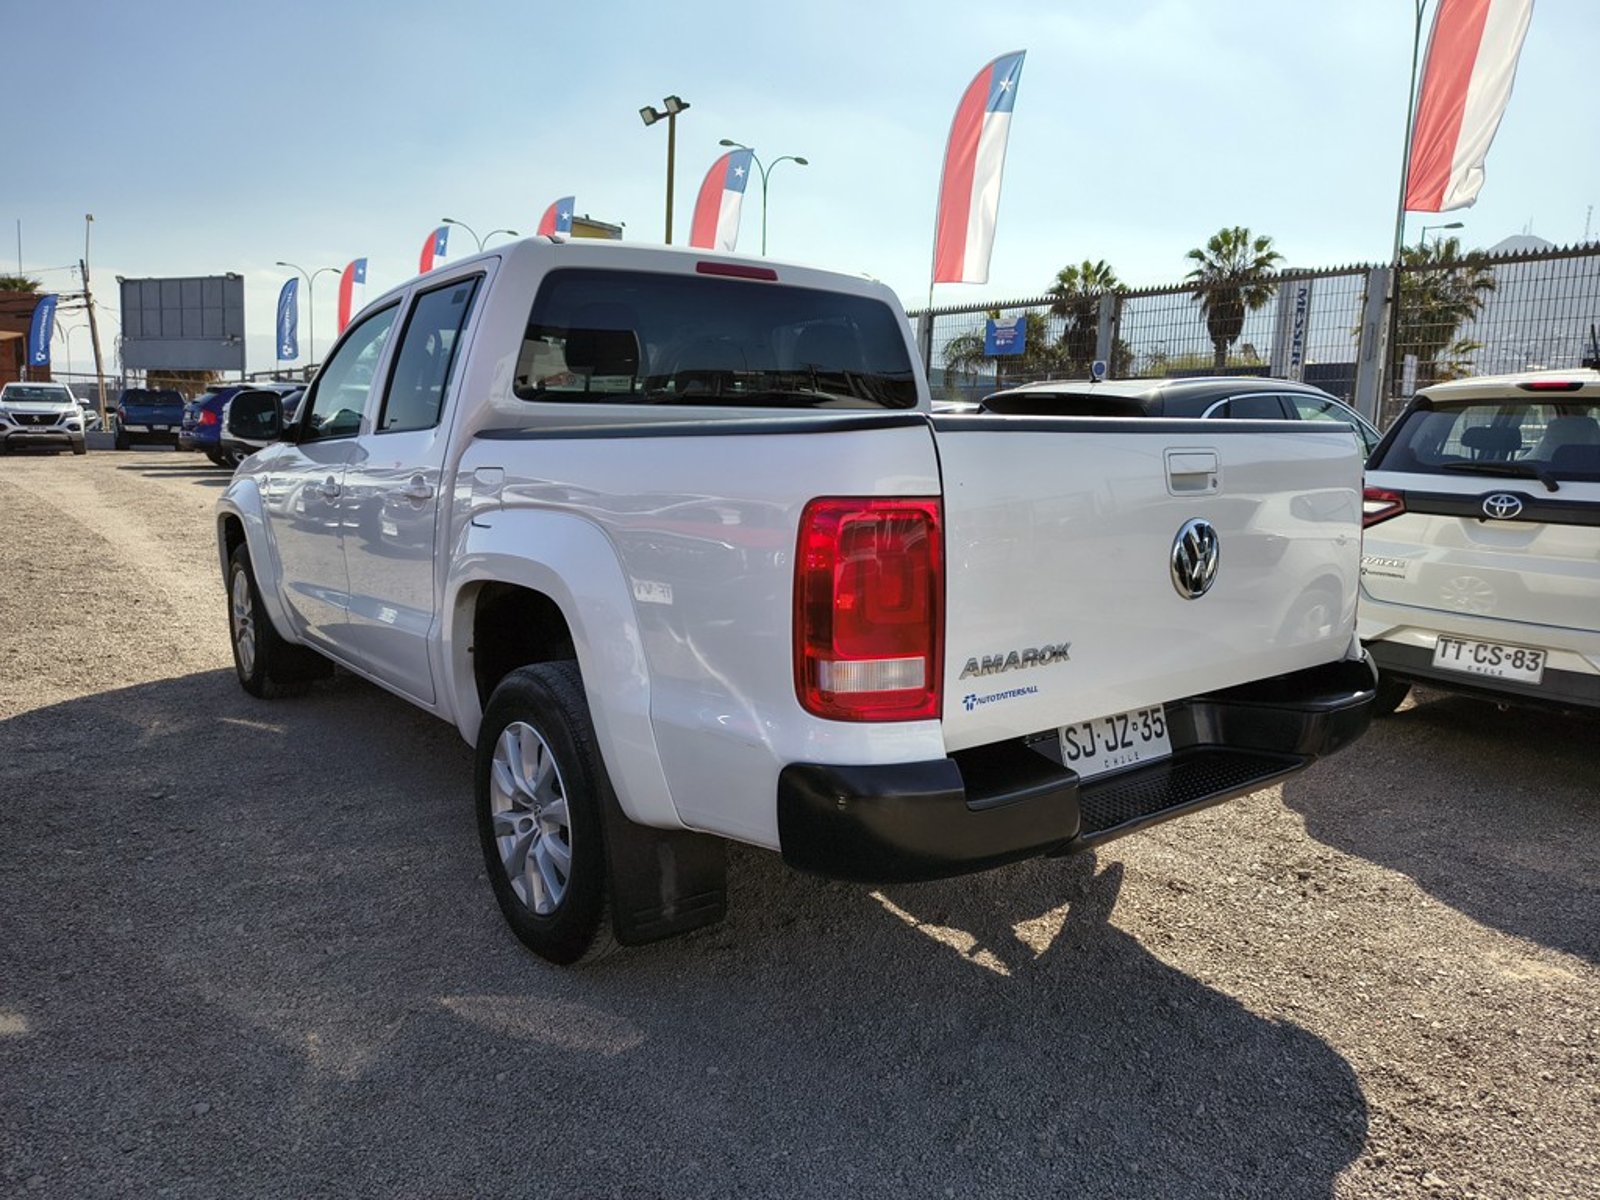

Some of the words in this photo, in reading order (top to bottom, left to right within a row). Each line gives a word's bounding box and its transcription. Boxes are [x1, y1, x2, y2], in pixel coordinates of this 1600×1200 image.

[1292, 288, 1307, 366] MESSER
[958, 641, 1072, 680] AMAROK
[976, 685, 1038, 705] AUTOTATTERSALL
[1104, 752, 1139, 768] CHILE
